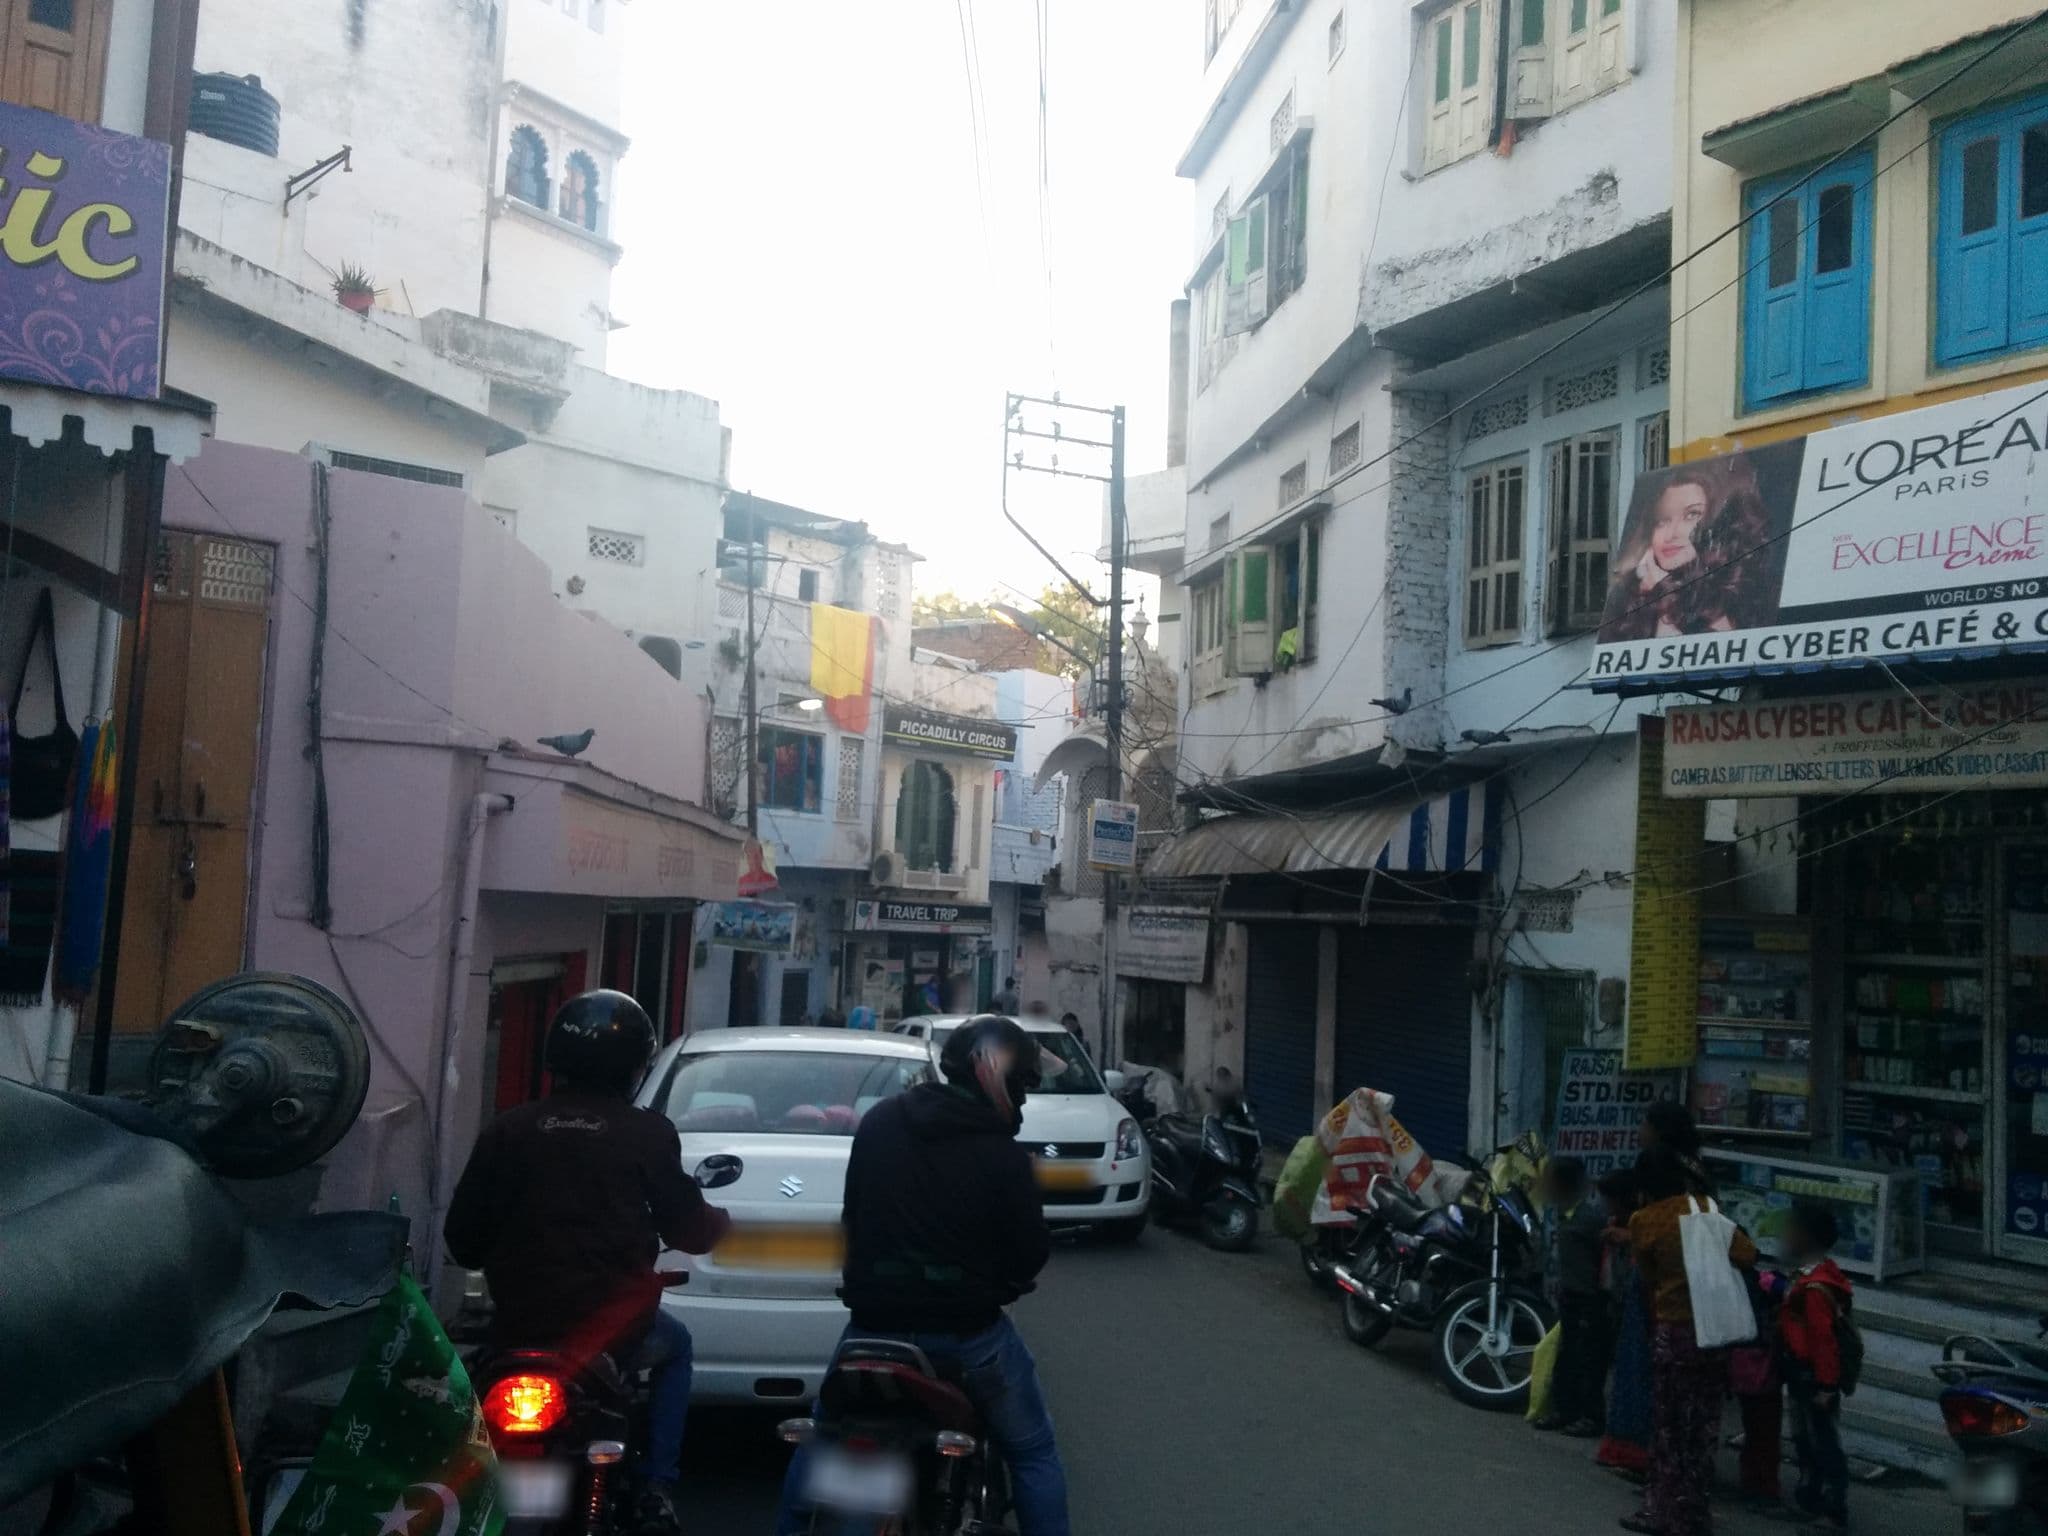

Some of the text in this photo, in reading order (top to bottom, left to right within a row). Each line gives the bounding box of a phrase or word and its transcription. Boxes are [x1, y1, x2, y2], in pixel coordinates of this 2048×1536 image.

[0, 151, 137, 280] ic
[1817, 417, 2048, 492] L'ORÉA
[1832, 514, 2046, 570] EXCELLENCE
[1924, 581, 2040, 607] WORLD'S NO
[1596, 647, 1650, 675] RAJ
[1659, 638, 1748, 668] SHAH
[1758, 627, 1870, 660] CYBER
[1881, 610, 1980, 650] CAFÉ
[1991, 611, 2021, 640] &
[899, 719, 966, 742] PICCADILLY
[968, 731, 1007, 749] CIRCUS
[1672, 708, 1751, 745] RAJSA
[1755, 702, 1848, 740] CYBER
[1855, 692, 1943, 735] CAFE
[886, 904, 959, 921] TRAVEL TRIP
